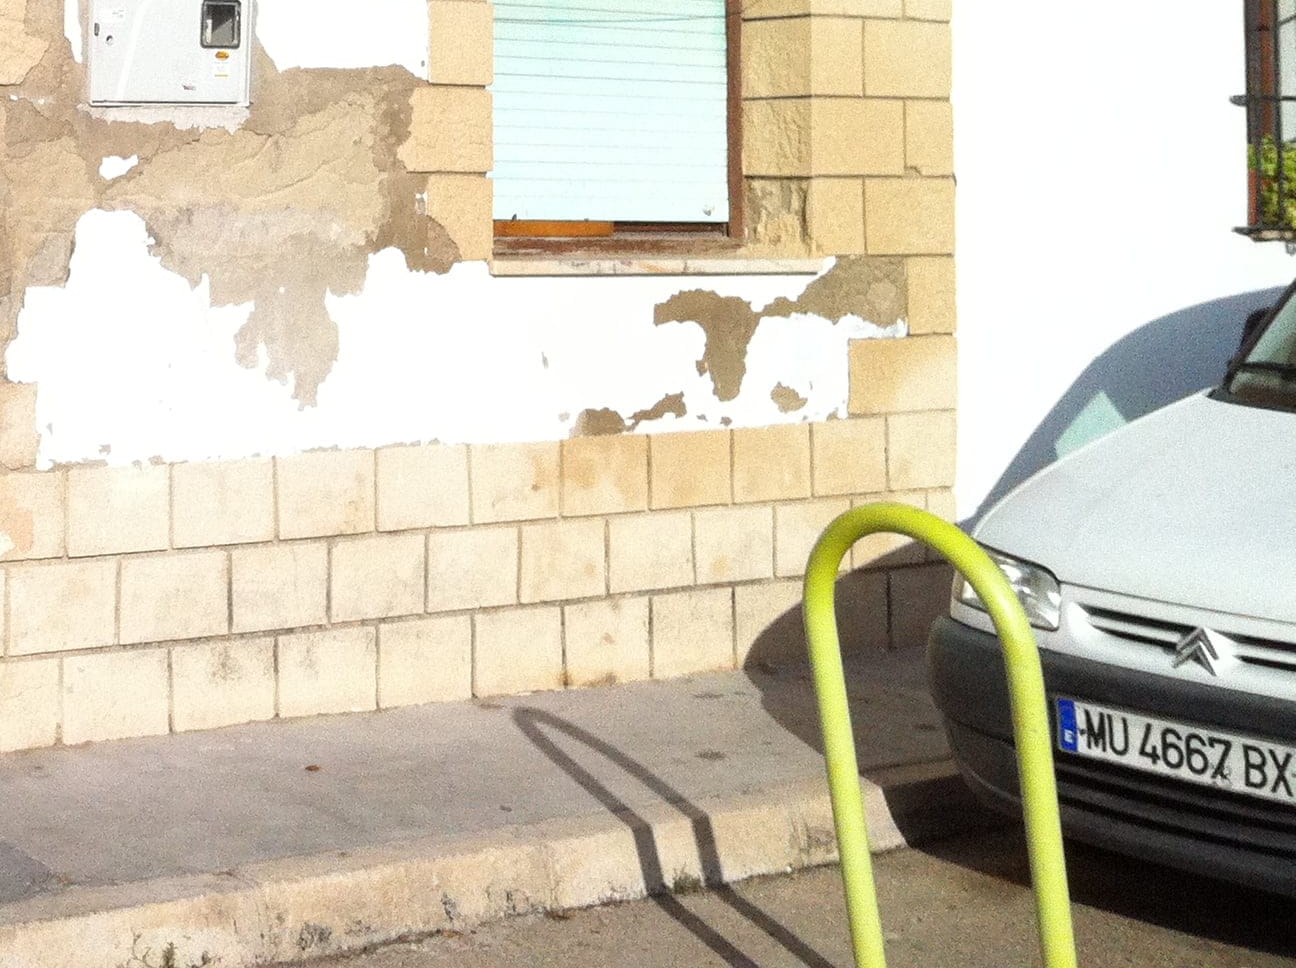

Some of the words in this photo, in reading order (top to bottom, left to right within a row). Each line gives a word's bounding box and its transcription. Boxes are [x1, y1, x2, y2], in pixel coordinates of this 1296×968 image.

[1083, 708, 1130, 756] MU
[1138, 722, 1233, 780] 4667
[1241, 743, 1294, 798] BX
